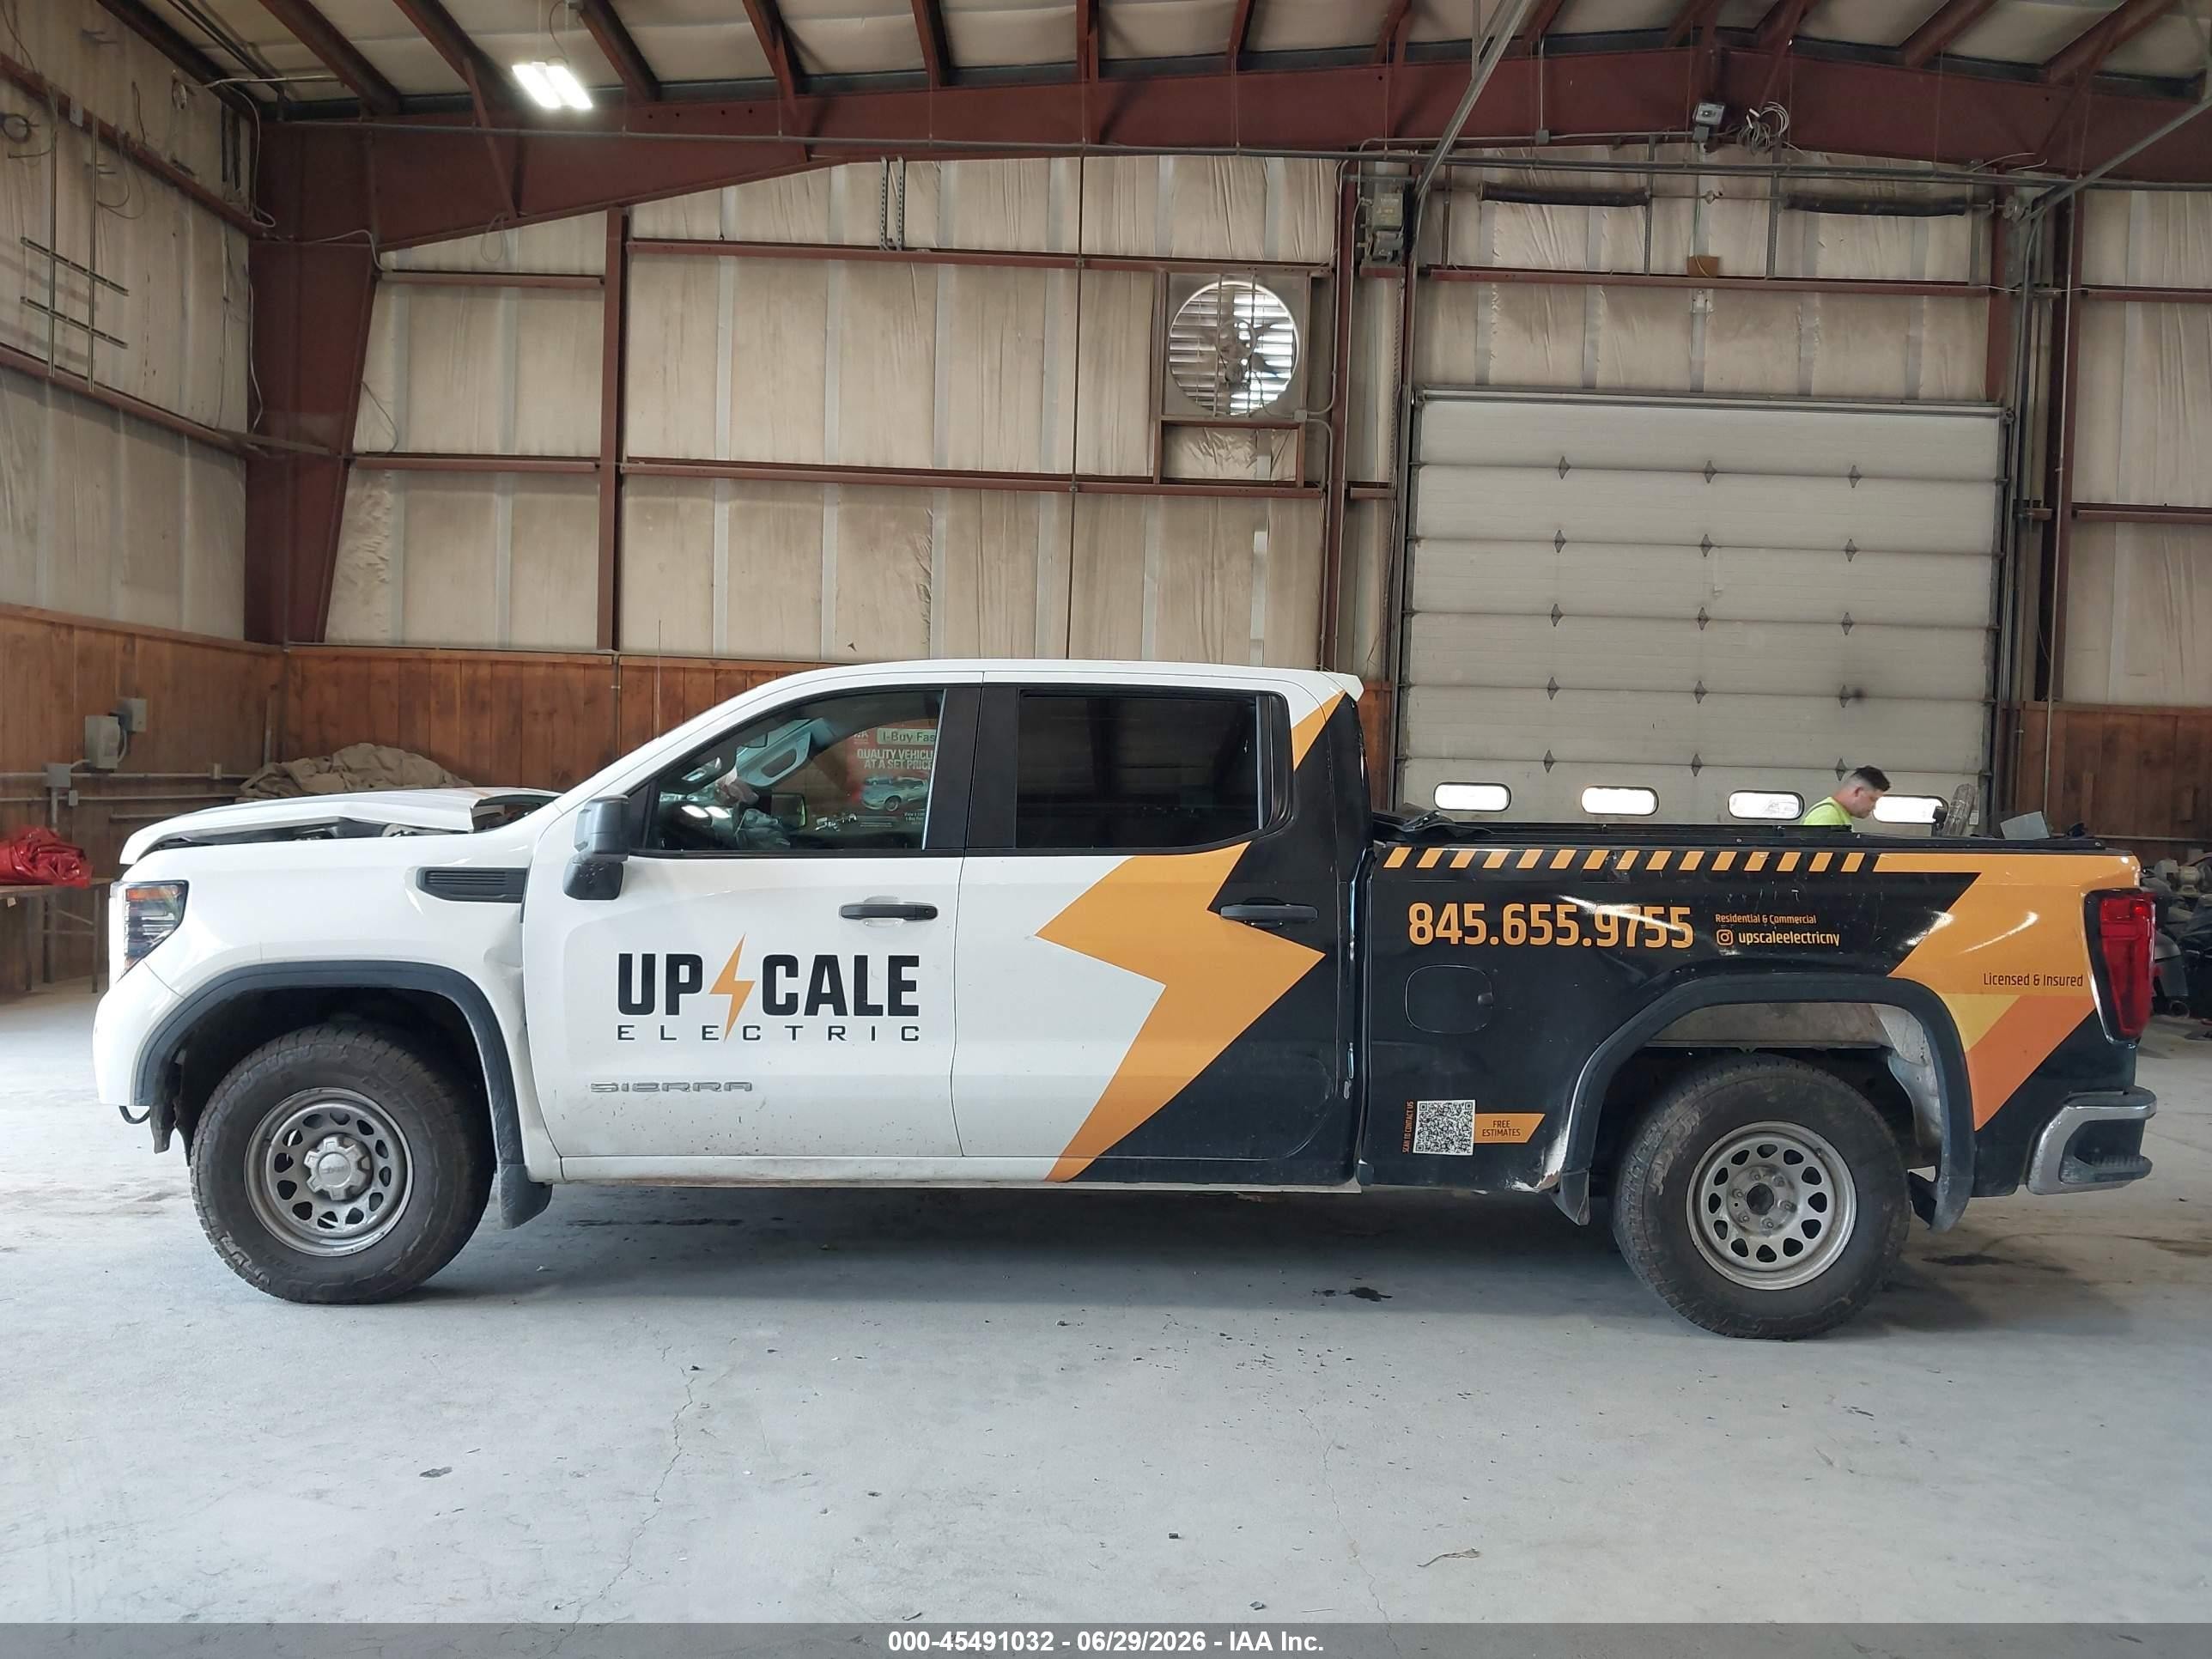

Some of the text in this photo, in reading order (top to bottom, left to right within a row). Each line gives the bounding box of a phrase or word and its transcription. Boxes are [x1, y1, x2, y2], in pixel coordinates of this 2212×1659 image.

[883, 731, 913, 743] I-Buy
[857, 748, 896, 760] QUALITY
[864, 760, 877, 769] AT
[878, 760, 885, 769] A
[887, 760, 904, 769] SET
[1408, 902, 1694, 949] 845.655.9755
[1716, 914, 1817, 925] Residential & Commercial
[1738, 930, 1840, 947] upscaleelectricny
[1984, 972, 2083, 988] Licensed & Insured
[617, 1024, 920, 1042] ELECTRIC
[590, 1081, 753, 1093] SIERRA
[1406, 1101, 1414, 1109] US
[1404, 1111, 1413, 1133] CONTACT
[1492, 1120, 1510, 1128] FREE
[1482, 1128, 1521, 1137] ESTIMATES
